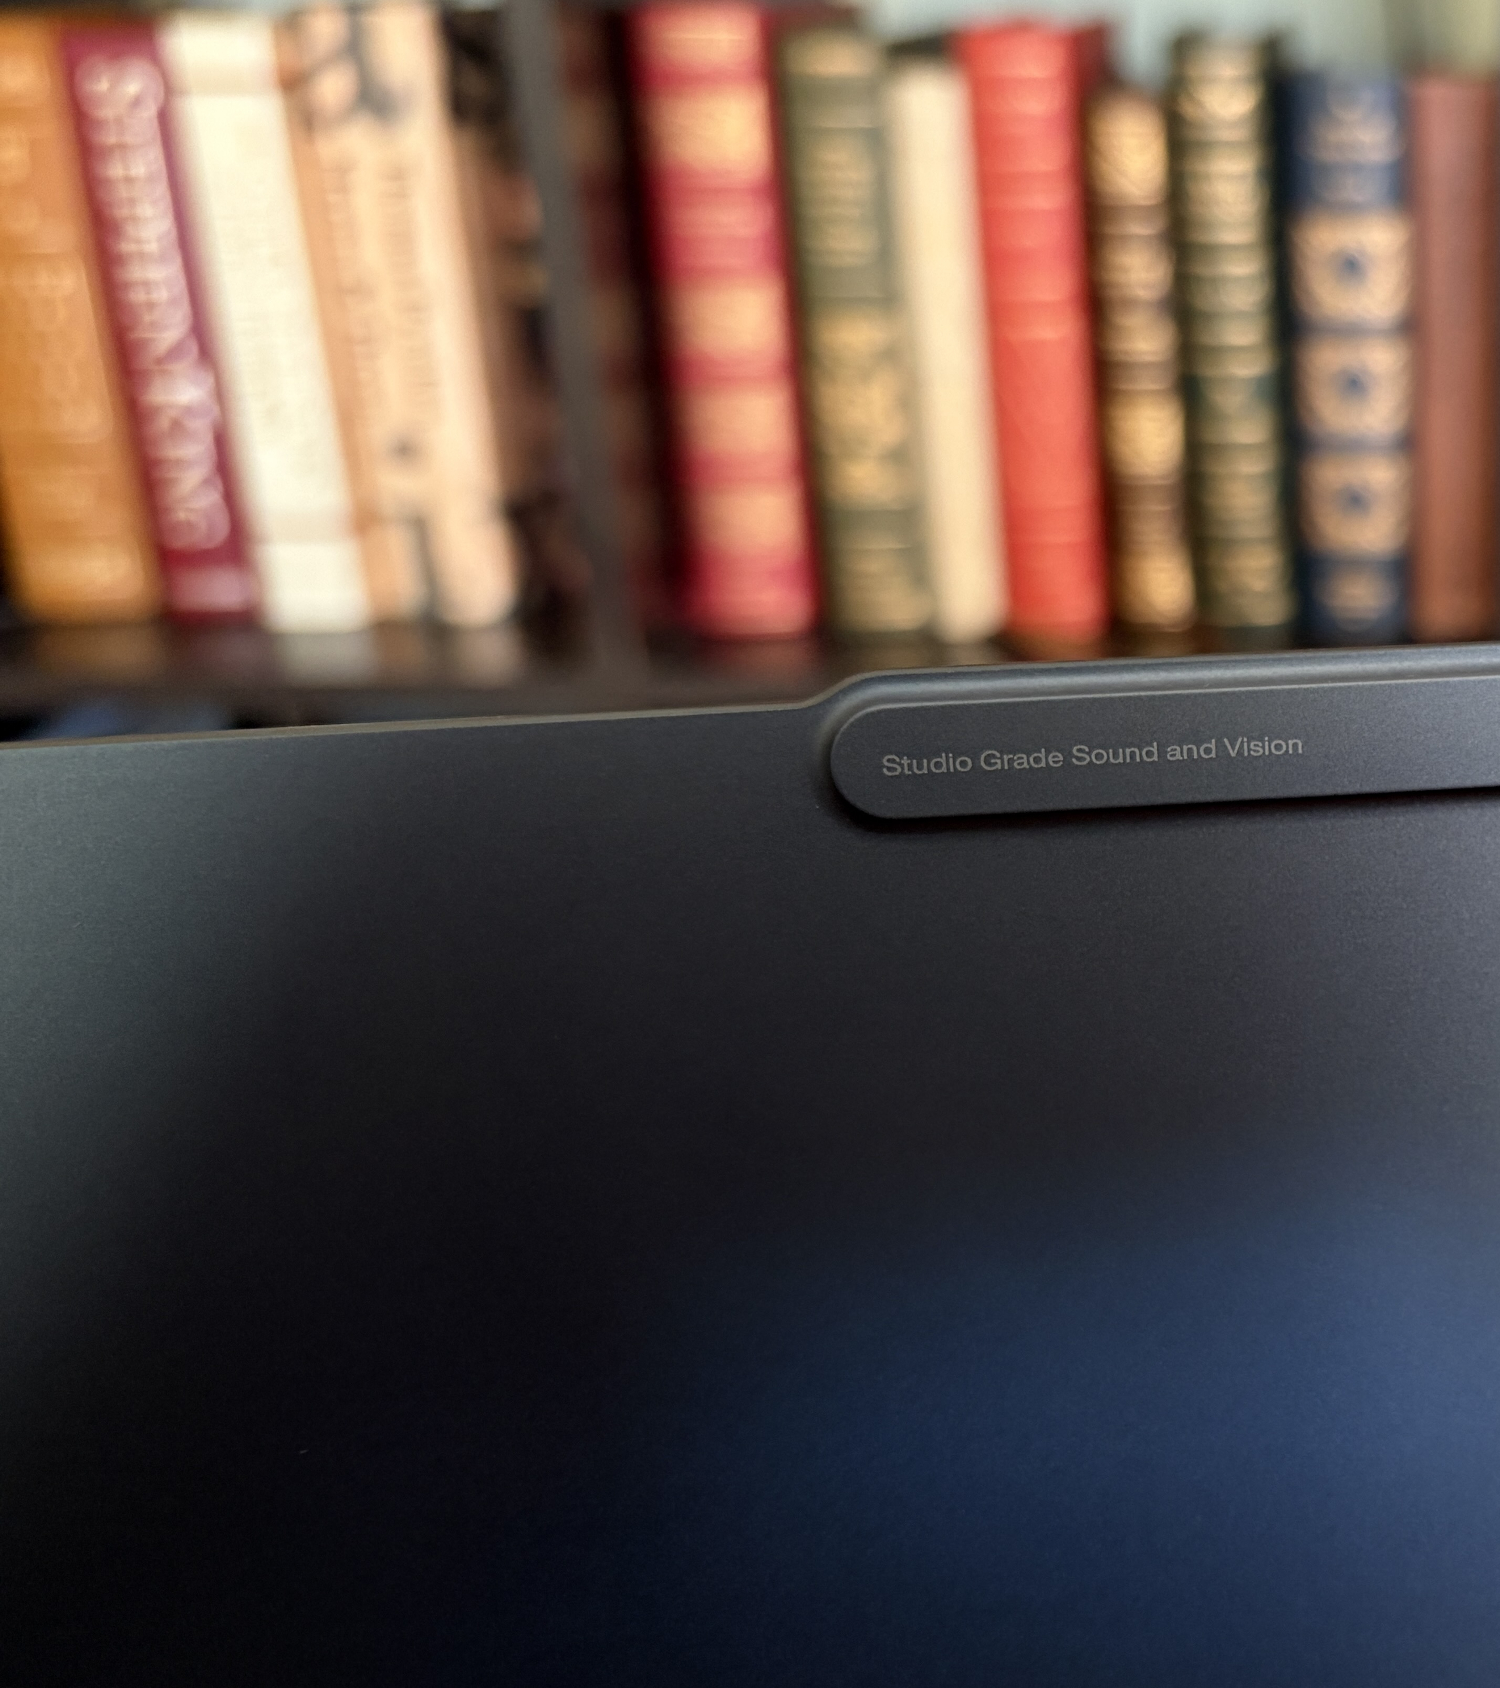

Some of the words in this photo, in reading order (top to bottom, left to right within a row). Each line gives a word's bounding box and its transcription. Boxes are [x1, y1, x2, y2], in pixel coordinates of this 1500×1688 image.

[882, 749, 973, 776] Studio
[979, 748, 1064, 772] Grade
[1071, 741, 1159, 767] Sound
[1166, 738, 1216, 761] and
[1223, 736, 1303, 757] Vision
